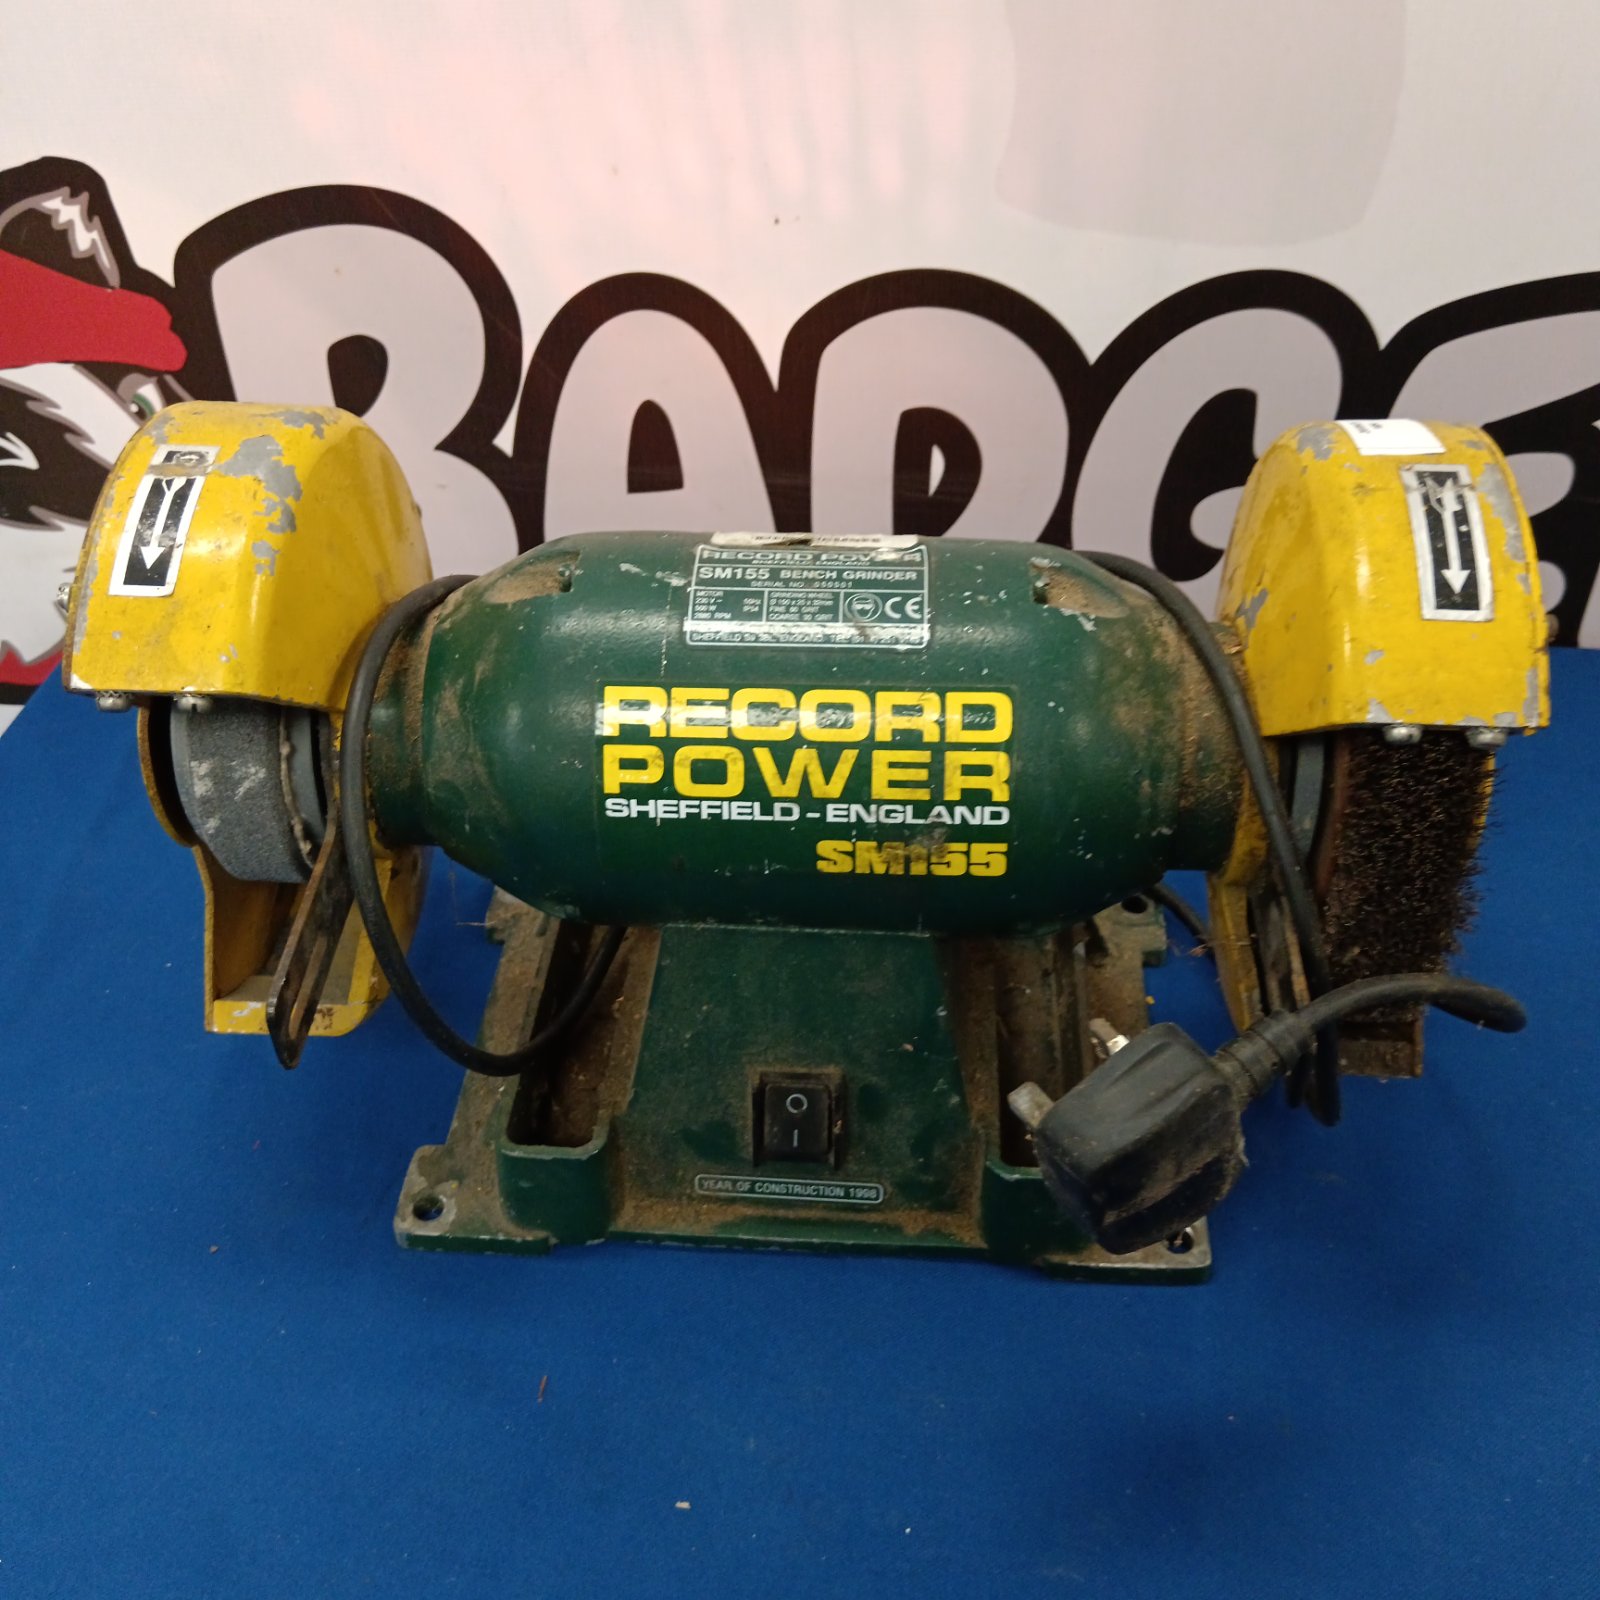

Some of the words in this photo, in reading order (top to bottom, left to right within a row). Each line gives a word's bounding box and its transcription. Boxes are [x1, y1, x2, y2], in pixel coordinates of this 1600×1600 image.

[702, 549, 813, 561] RECORD
[819, 552, 922, 562] POWR
[698, 567, 770, 580] SM155
[779, 569, 838, 580] BENCH
[842, 570, 918, 581] GRINDER
[750, 580, 786, 588] SERIAL
[602, 685, 1014, 744] RECORD
[601, 744, 1011, 803] POWER
[815, 839, 1008, 877] SM155
[701, 1179, 733, 1191] YEAR
[735, 1180, 752, 1192] OF
[754, 1182, 845, 1197] CONSTRUCTION
